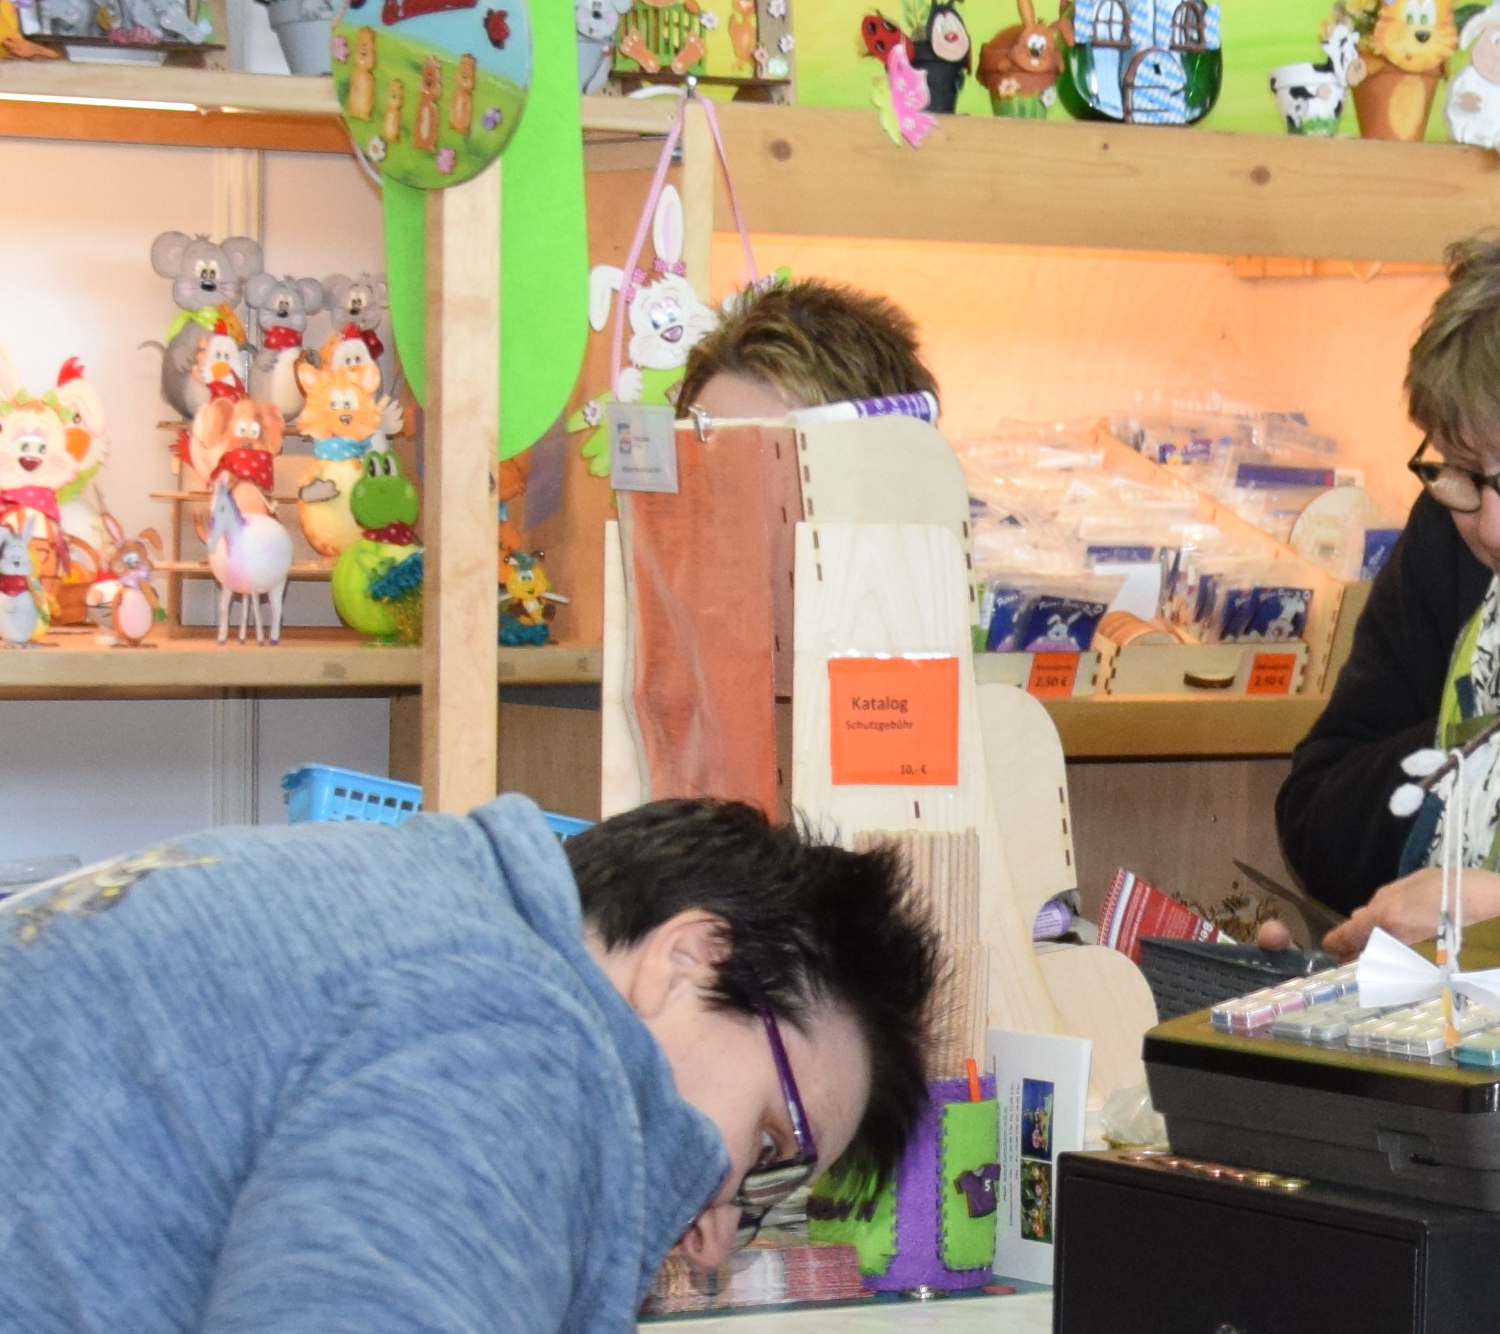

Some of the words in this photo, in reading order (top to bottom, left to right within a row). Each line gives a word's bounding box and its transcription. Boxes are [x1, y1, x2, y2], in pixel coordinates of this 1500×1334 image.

[851, 696, 908, 714] Katalog
[845, 719, 914, 732] Schutzgebühr
[920, 764, 927, 775] €
[984, 1179, 992, 1192] 5
